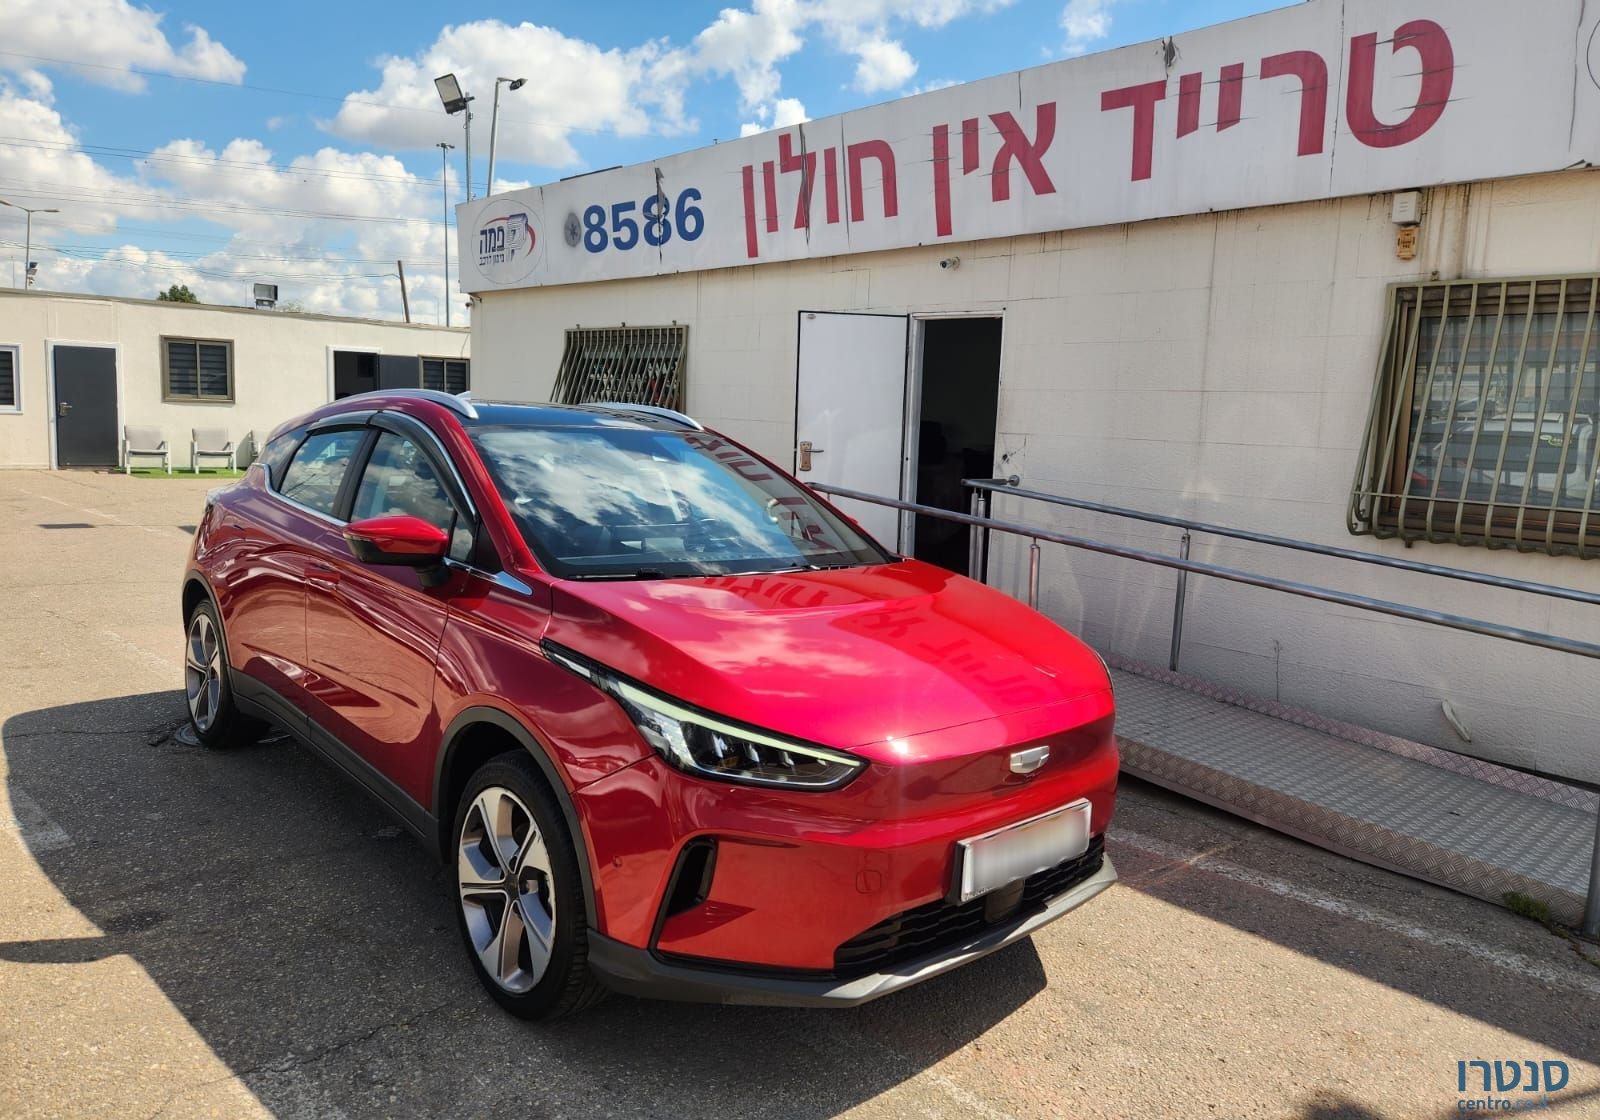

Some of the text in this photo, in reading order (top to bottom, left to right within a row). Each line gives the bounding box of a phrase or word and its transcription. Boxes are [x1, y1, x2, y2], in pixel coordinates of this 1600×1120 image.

[742, 19, 1454, 258] טרייד אין חולון
[583, 187, 705, 254] 8586
